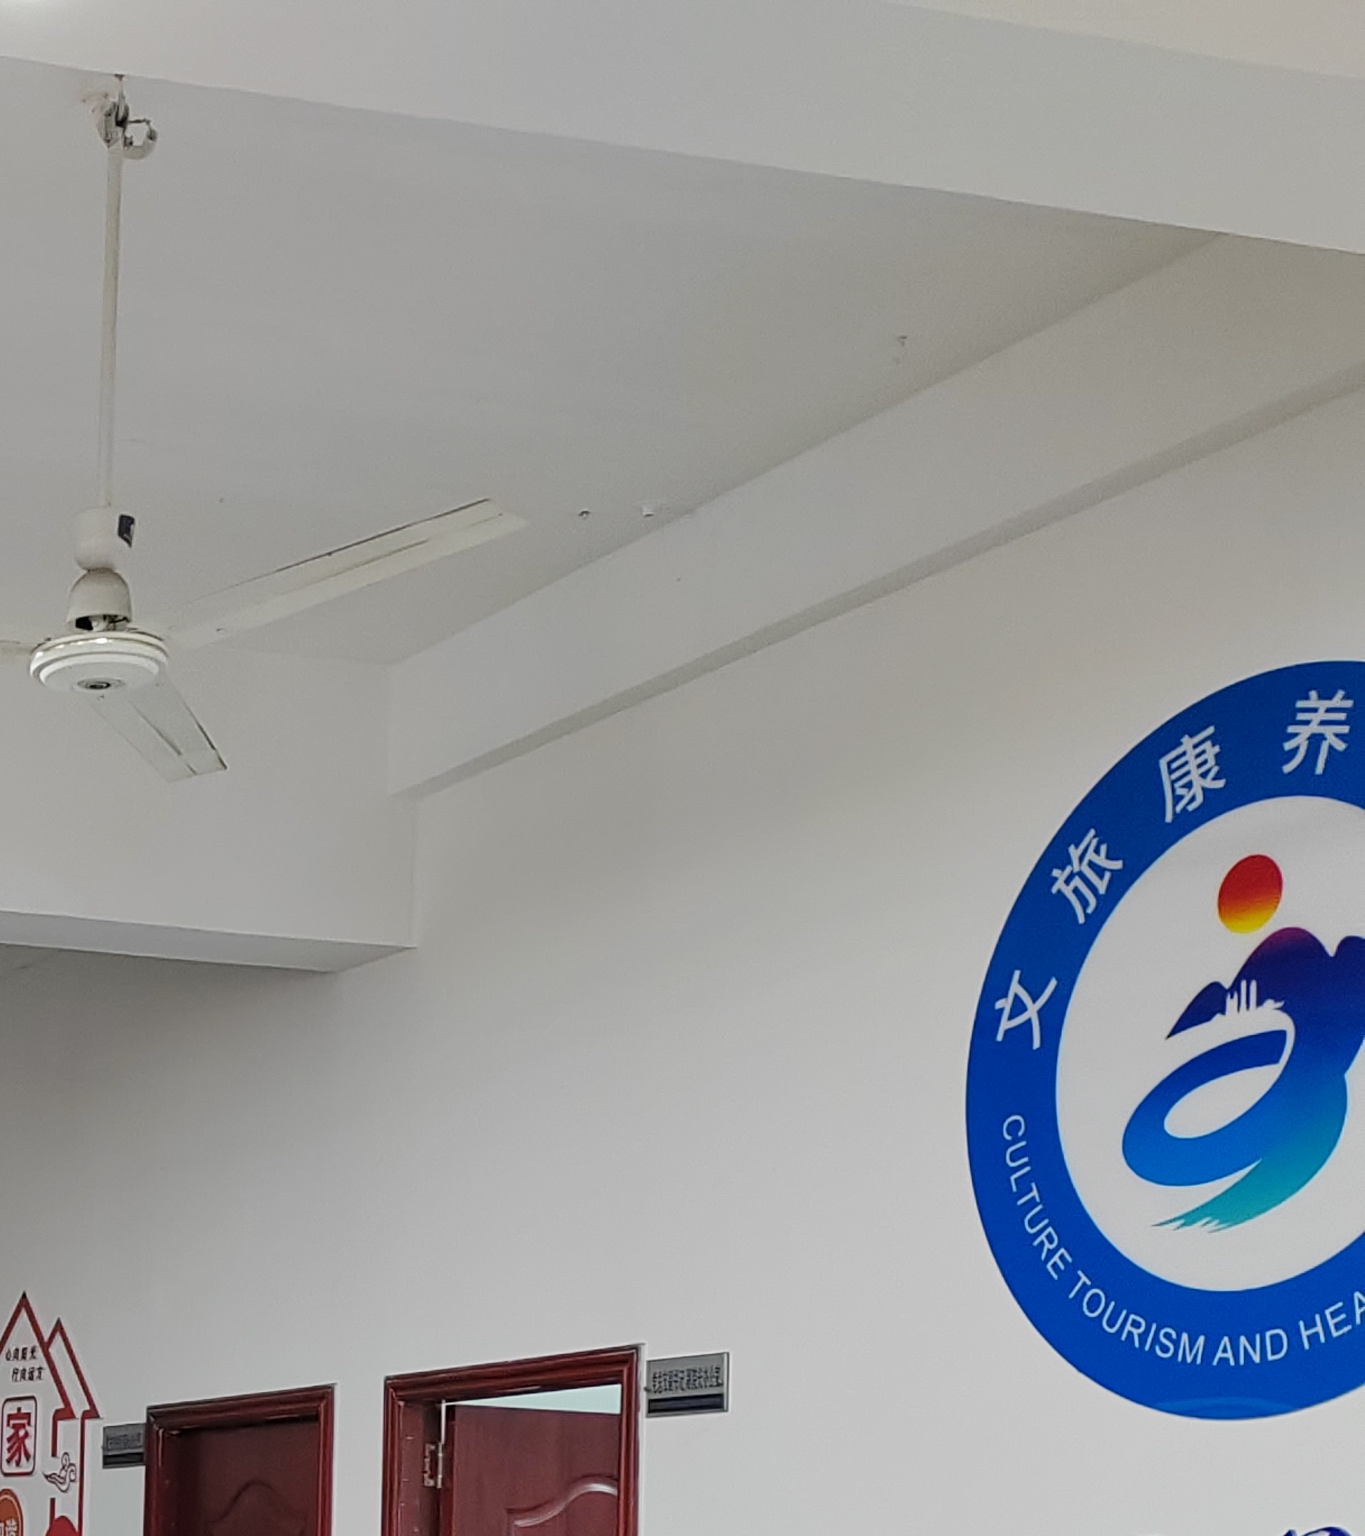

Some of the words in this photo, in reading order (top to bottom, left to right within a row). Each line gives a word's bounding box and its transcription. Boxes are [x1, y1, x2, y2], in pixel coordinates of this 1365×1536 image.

[995, 689, 1356, 1050] 文旅康养
[1001, 1113, 1073, 1281] CULTURE
[1068, 1272, 1205, 1366] TOURISM
[1212, 1326, 1289, 1367] AND
